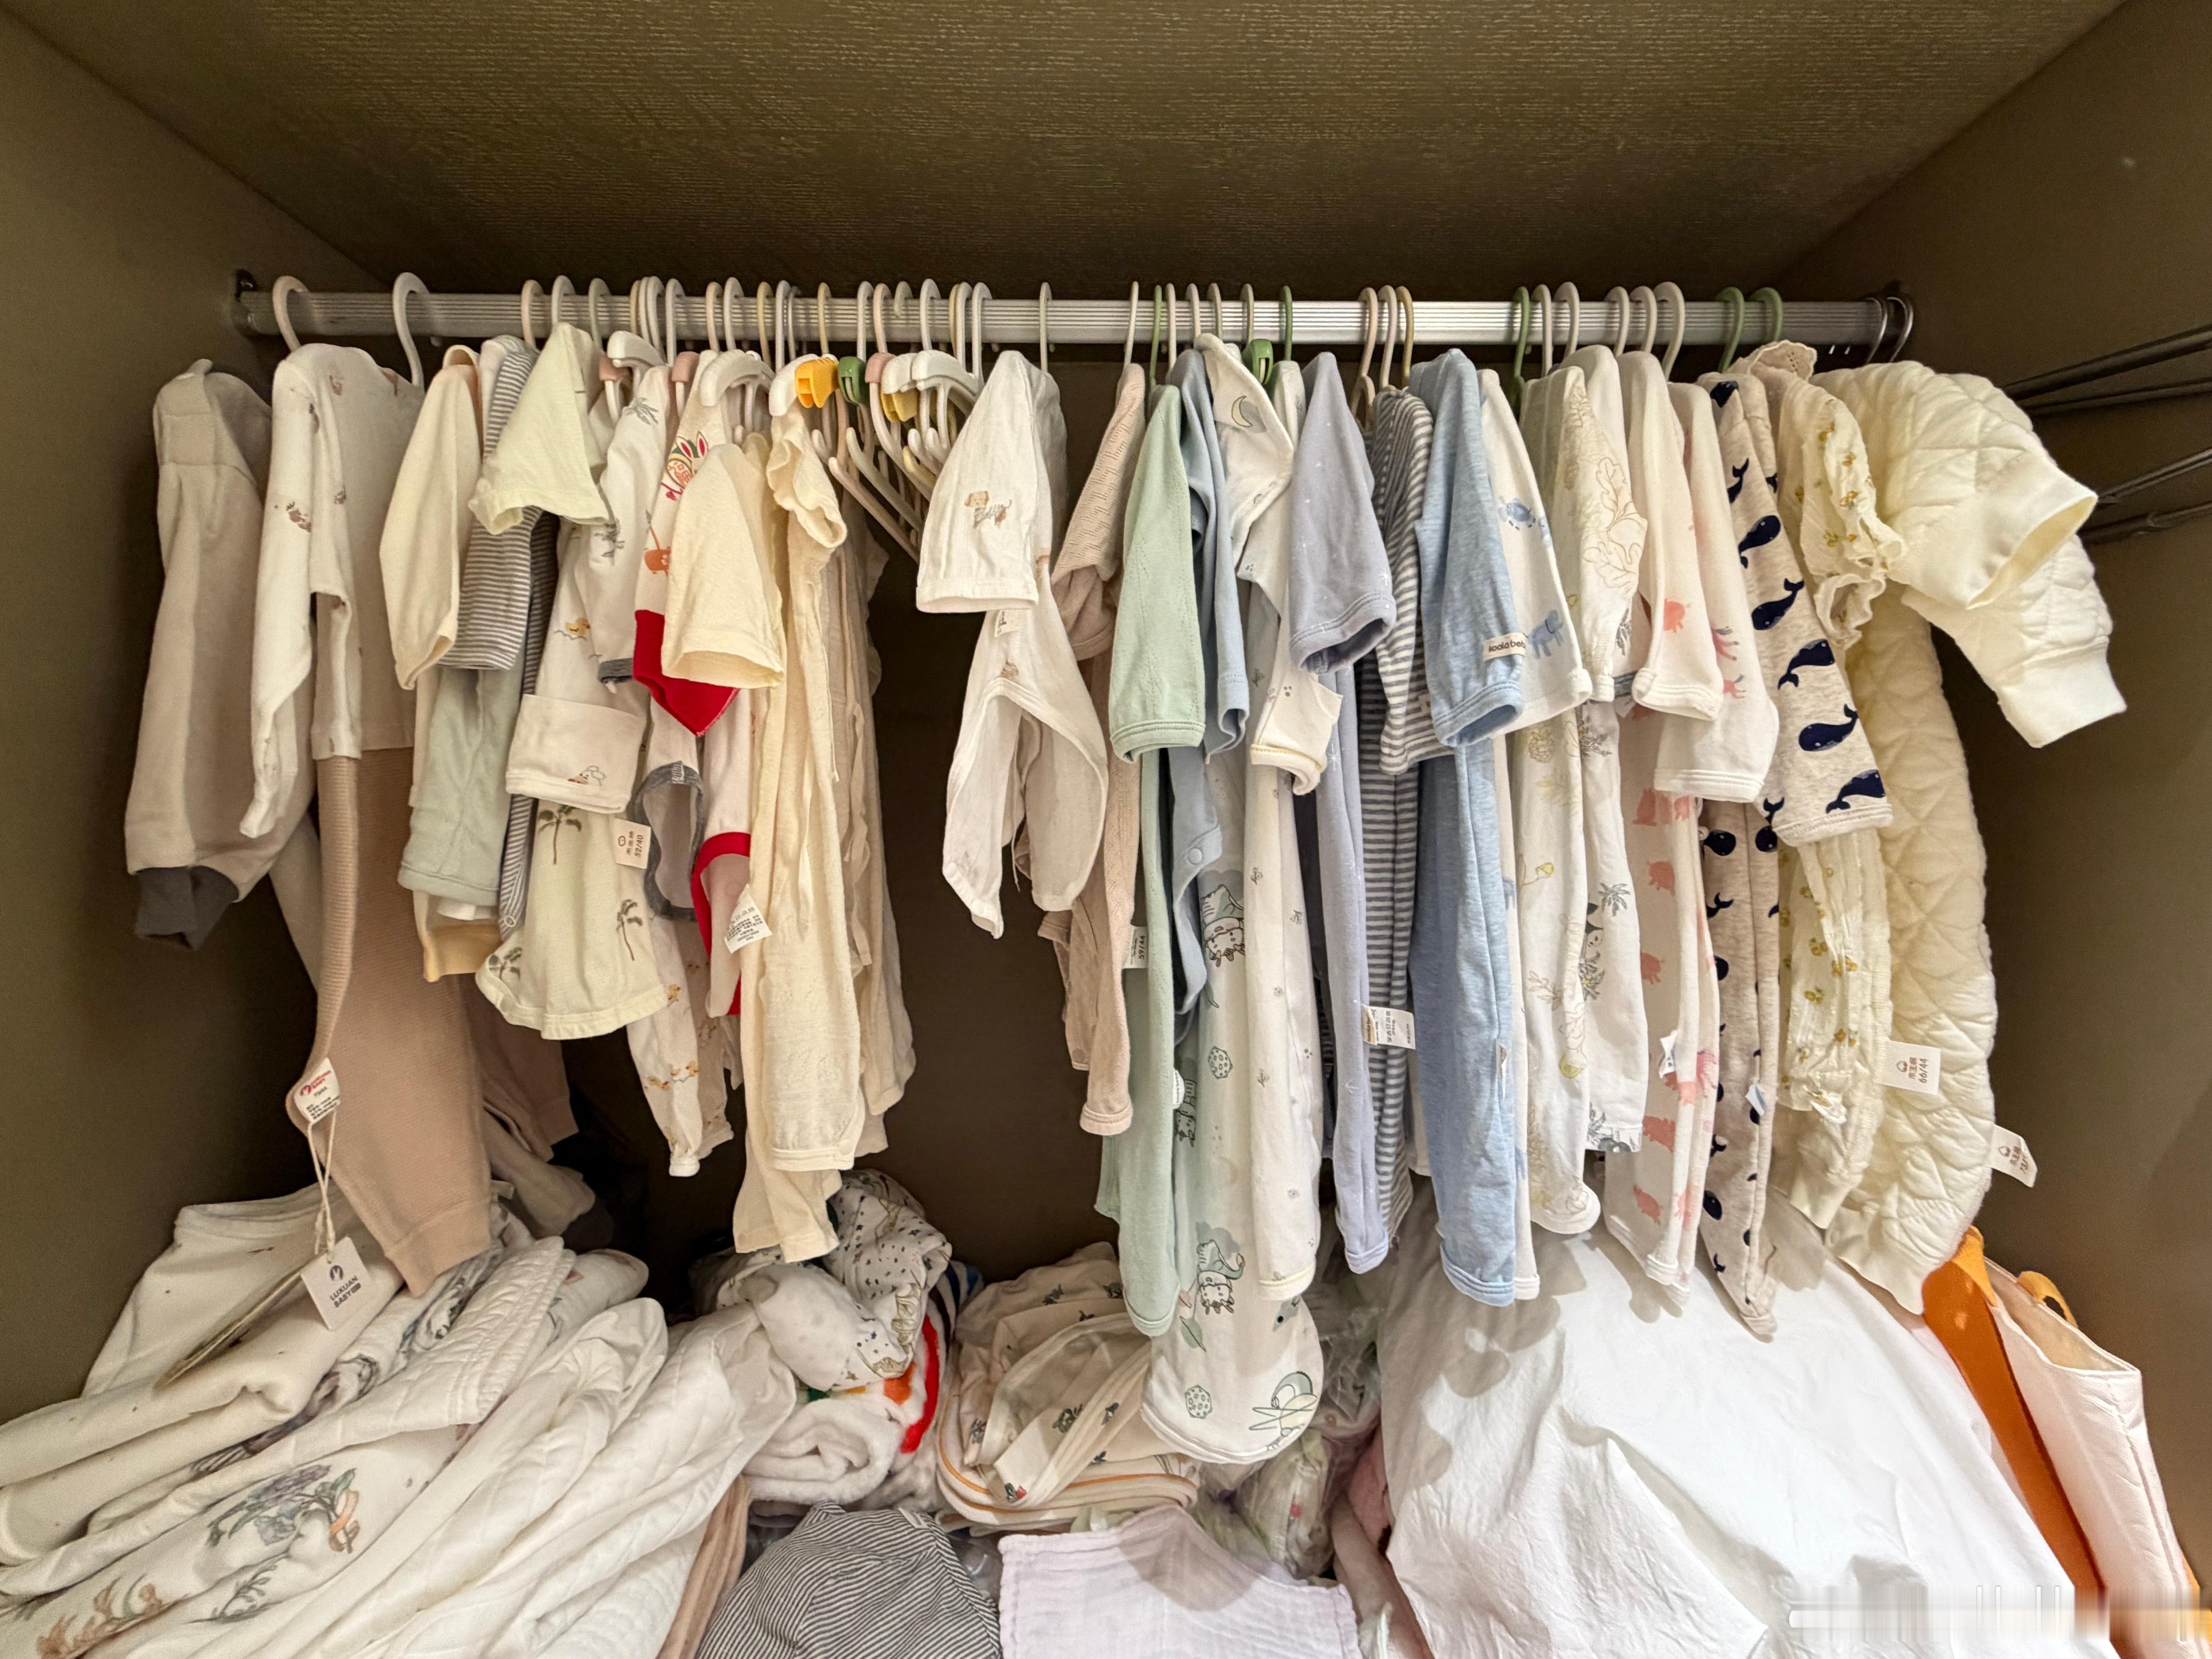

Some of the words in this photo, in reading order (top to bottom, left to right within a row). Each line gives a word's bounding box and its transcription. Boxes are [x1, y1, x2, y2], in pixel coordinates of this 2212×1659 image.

[1488, 641, 1509, 653] koala
[635, 835, 644, 857] 52/40
[1918, 1058, 1928, 1083] 66/44
[330, 1275, 359, 1301] LUXUAN
